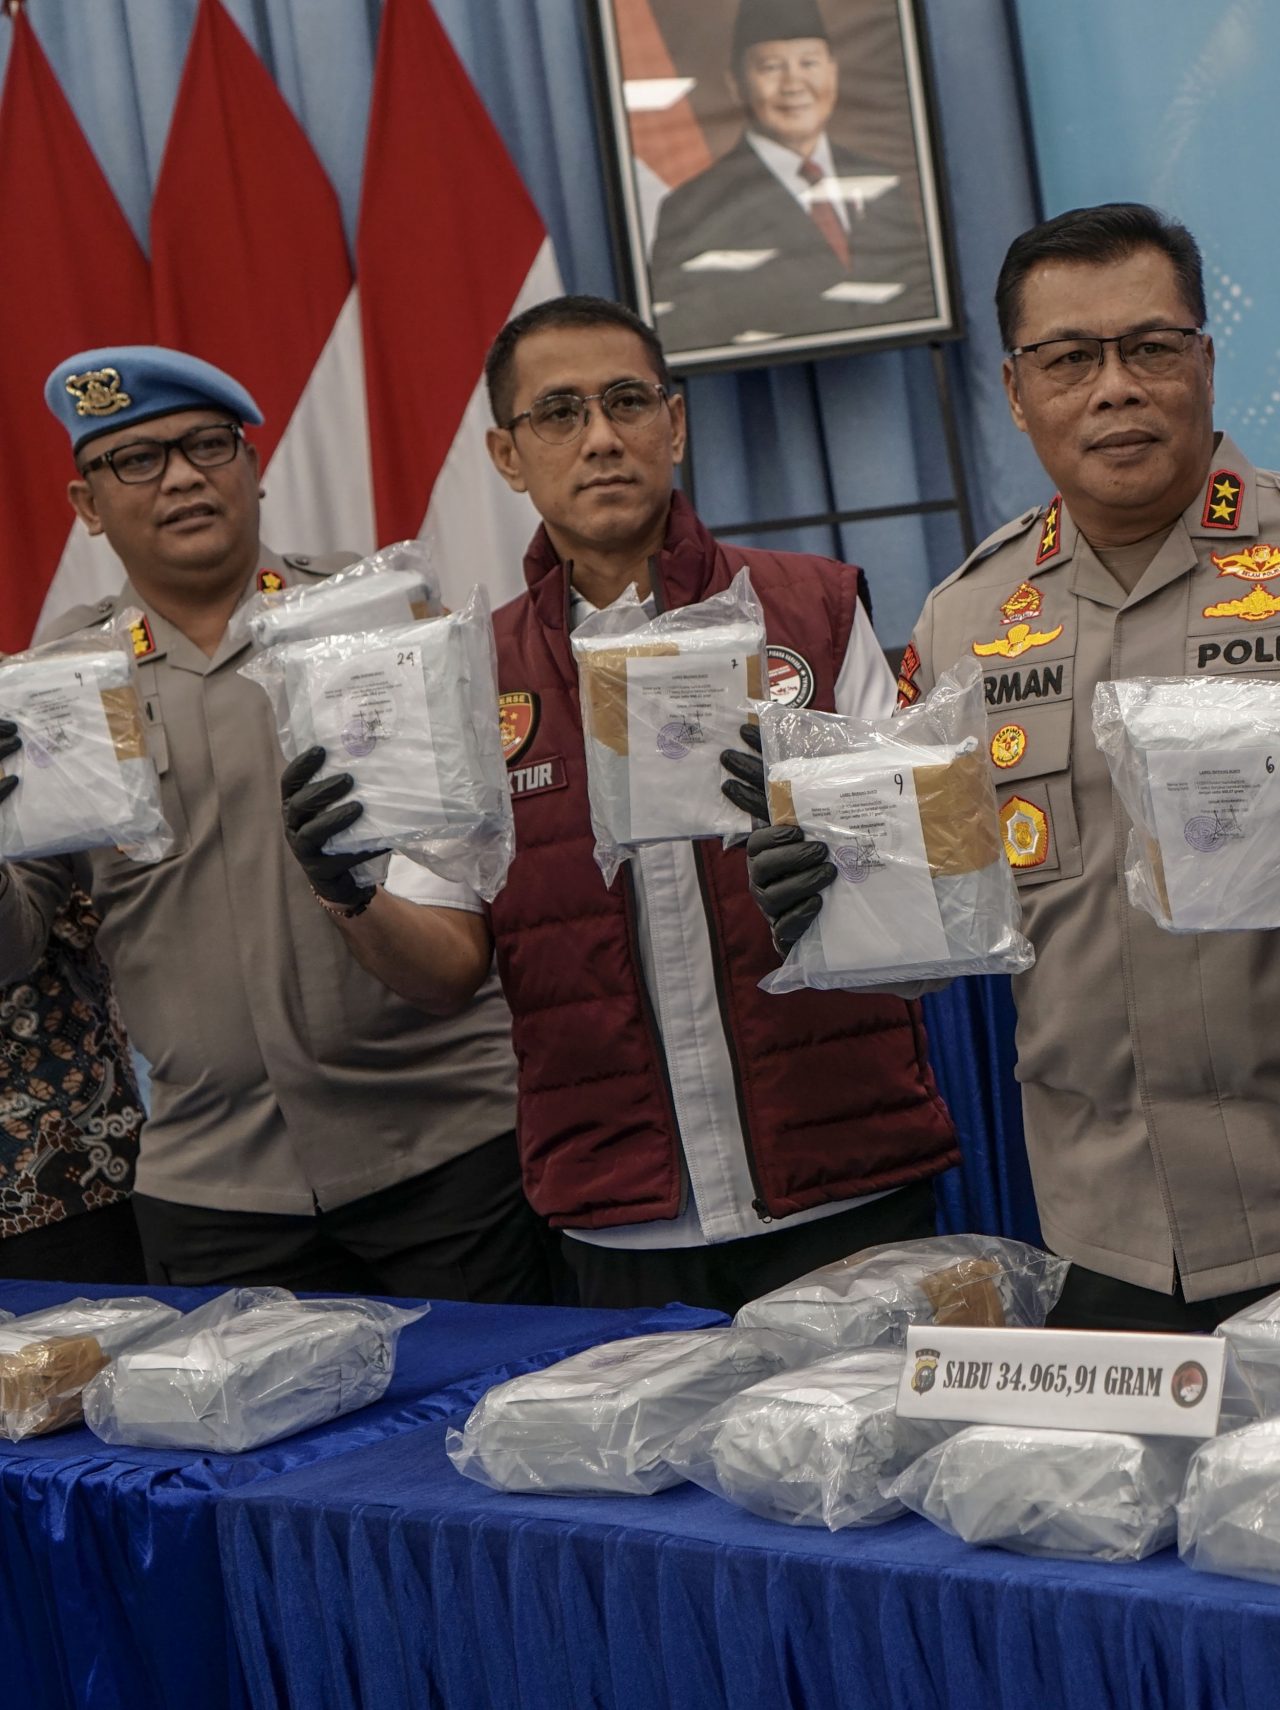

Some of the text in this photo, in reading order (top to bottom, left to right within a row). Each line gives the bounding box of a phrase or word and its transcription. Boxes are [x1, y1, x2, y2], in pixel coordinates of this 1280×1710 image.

[1262, 568, 1280, 577] POLRI
[984, 664, 1064, 705] RMAN
[1266, 755, 1275, 774] 6
[894, 773, 904, 796] 9
[943, 1360, 1164, 1397] SABU 34.965,91 GRAM
